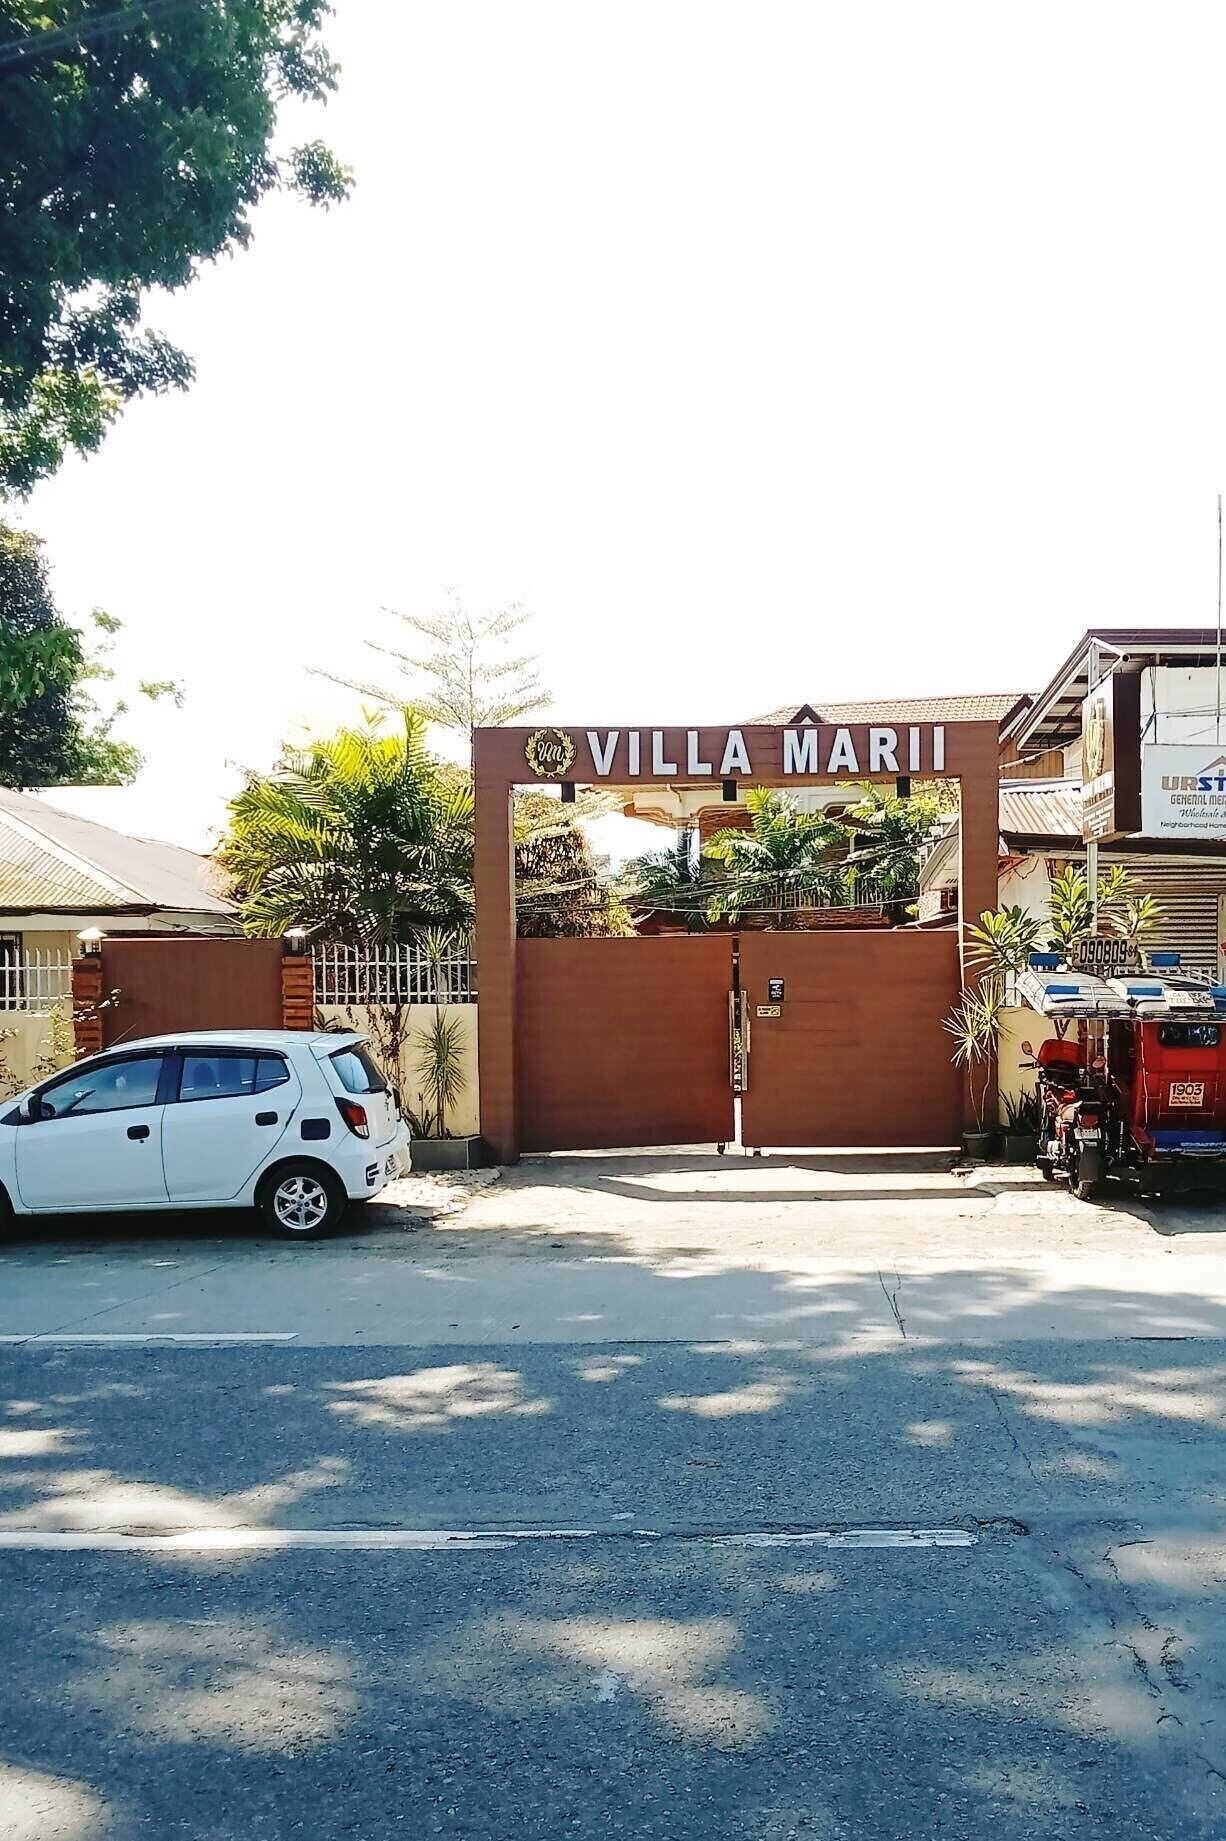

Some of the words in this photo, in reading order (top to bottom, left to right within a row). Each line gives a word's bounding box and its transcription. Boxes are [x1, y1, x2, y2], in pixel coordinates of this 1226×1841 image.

[585, 730, 753, 776] VILLA
[782, 725, 946, 774] MARII
[1170, 794, 1208, 806] GENERAL
[1179, 807, 1219, 818] Wholesale
[1160, 821, 1208, 829] Neighborhood
